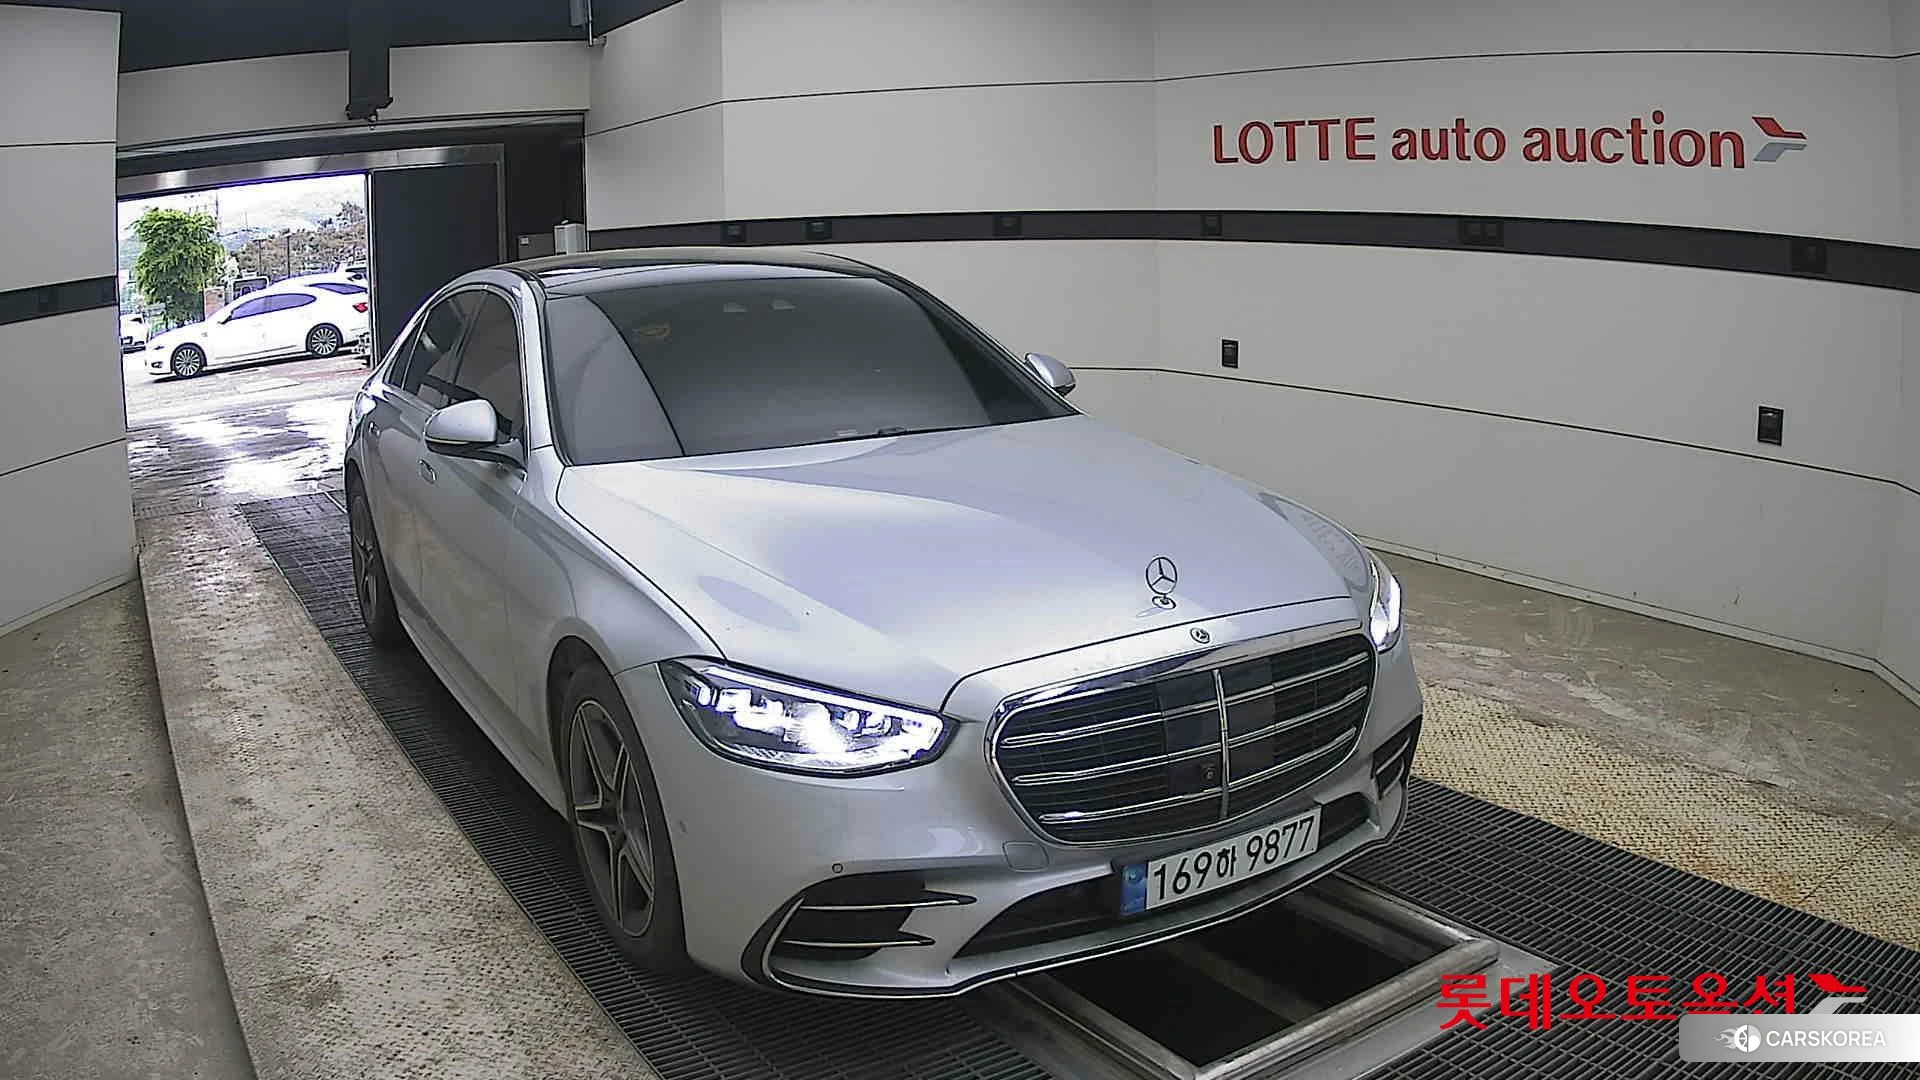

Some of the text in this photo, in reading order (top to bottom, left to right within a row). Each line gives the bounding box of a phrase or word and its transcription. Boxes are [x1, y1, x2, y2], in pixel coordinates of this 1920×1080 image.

[1212, 109, 1746, 169] LOTTE auto auction
[1153, 815, 1315, 900] 169하 9877
